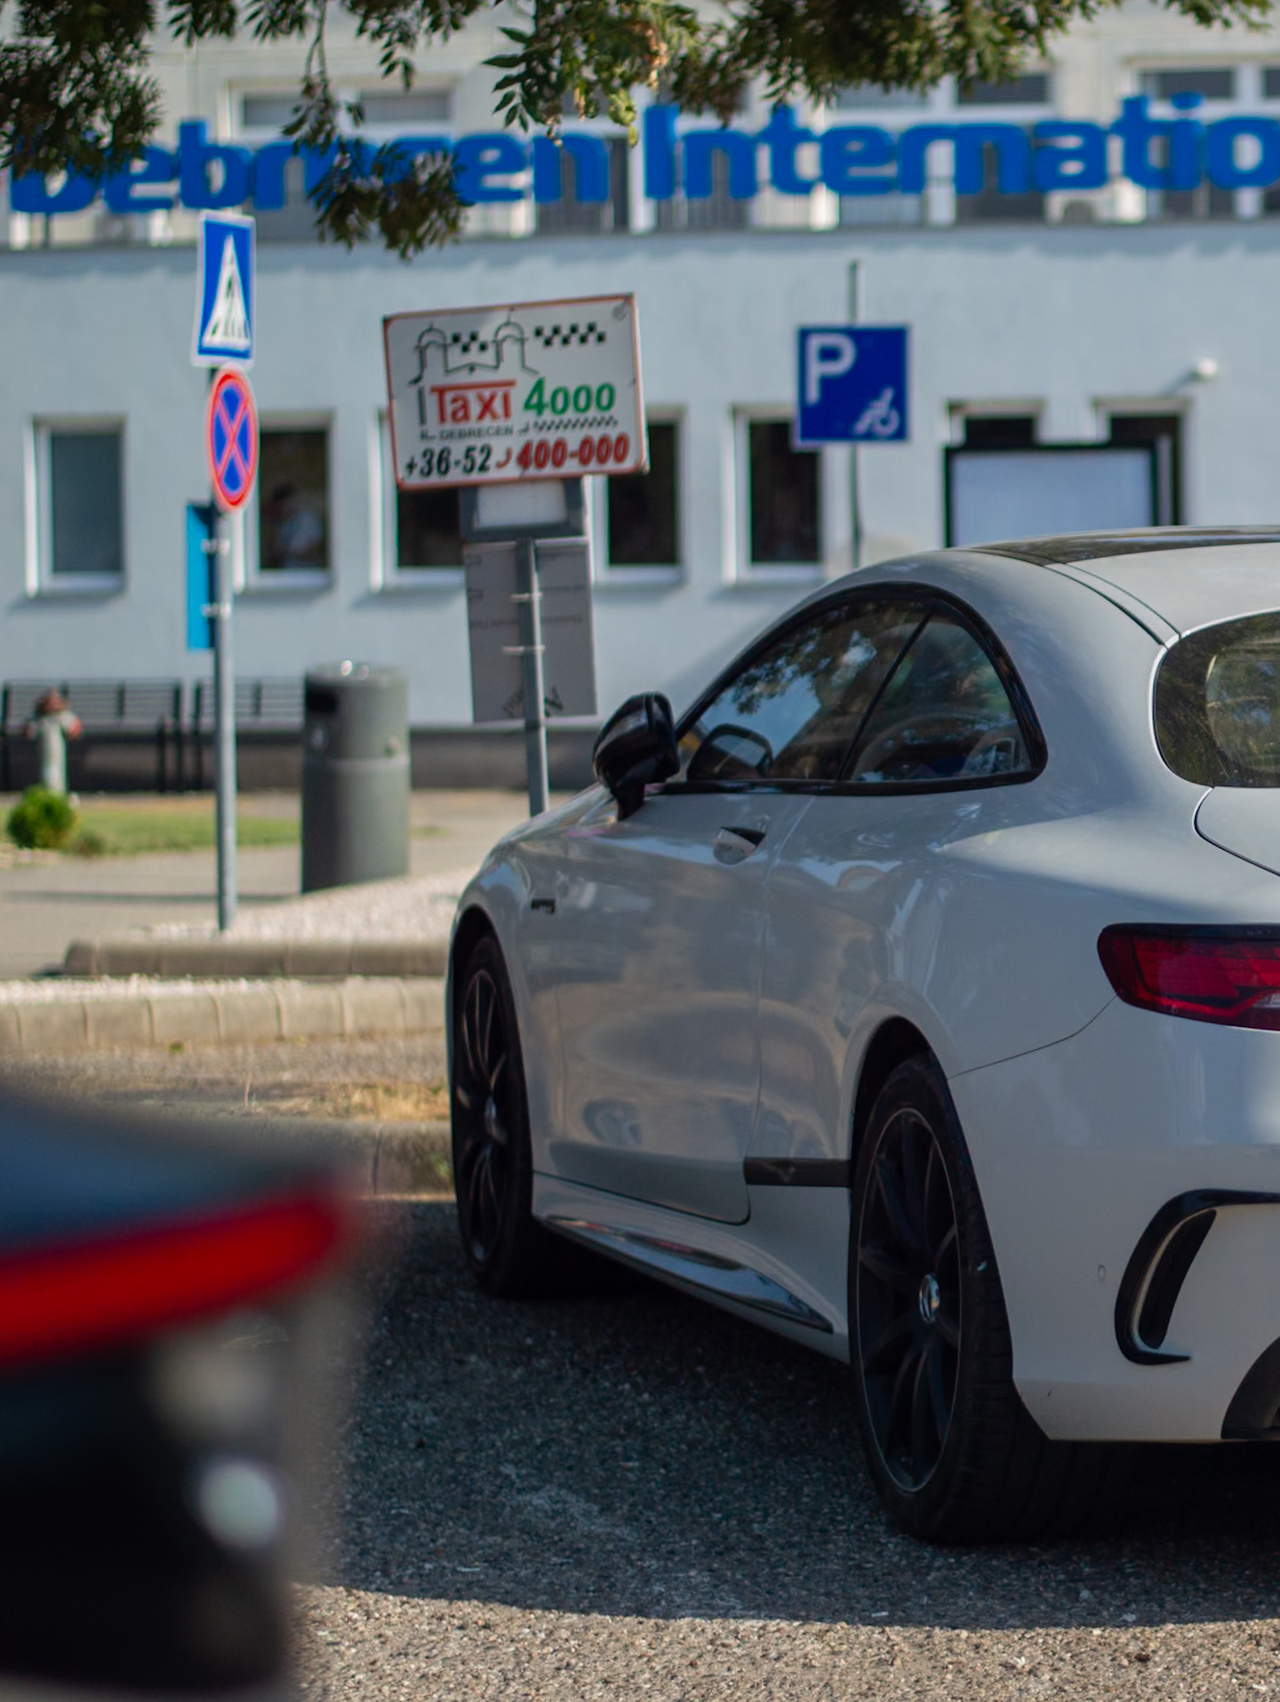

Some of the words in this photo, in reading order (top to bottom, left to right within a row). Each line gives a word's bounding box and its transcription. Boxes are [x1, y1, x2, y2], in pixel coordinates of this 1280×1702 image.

[804, 332, 857, 406] P
[430, 379, 517, 426] Taxi
[523, 377, 616, 419] 4000
[405, 443, 493, 478] +36-52
[517, 432, 630, 471] 400-000
